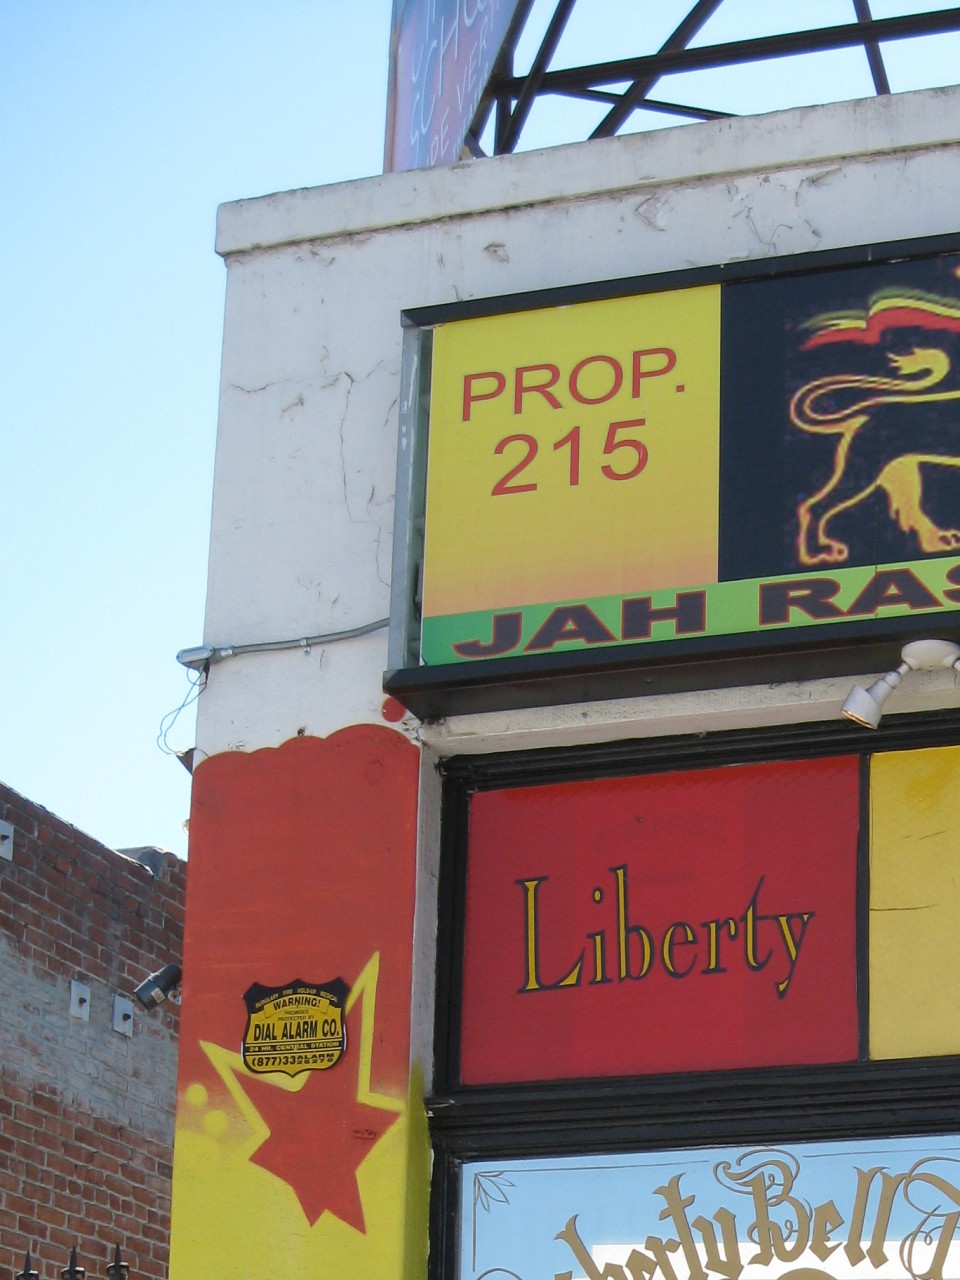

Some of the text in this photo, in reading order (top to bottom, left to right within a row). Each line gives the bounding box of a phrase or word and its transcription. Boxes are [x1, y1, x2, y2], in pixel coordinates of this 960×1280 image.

[460, 346, 687, 422] PROP.
[490, 418, 649, 497] 215
[451, 589, 708, 660] JAH
[515, 864, 815, 1000] Liberty
[253, 1018, 340, 1042] DIAL ALARM CO.
[272, 996, 320, 1011] WARNING!
[275, 1043, 309, 1051] CENTRAL
[310, 1041, 340, 1049] STATION
